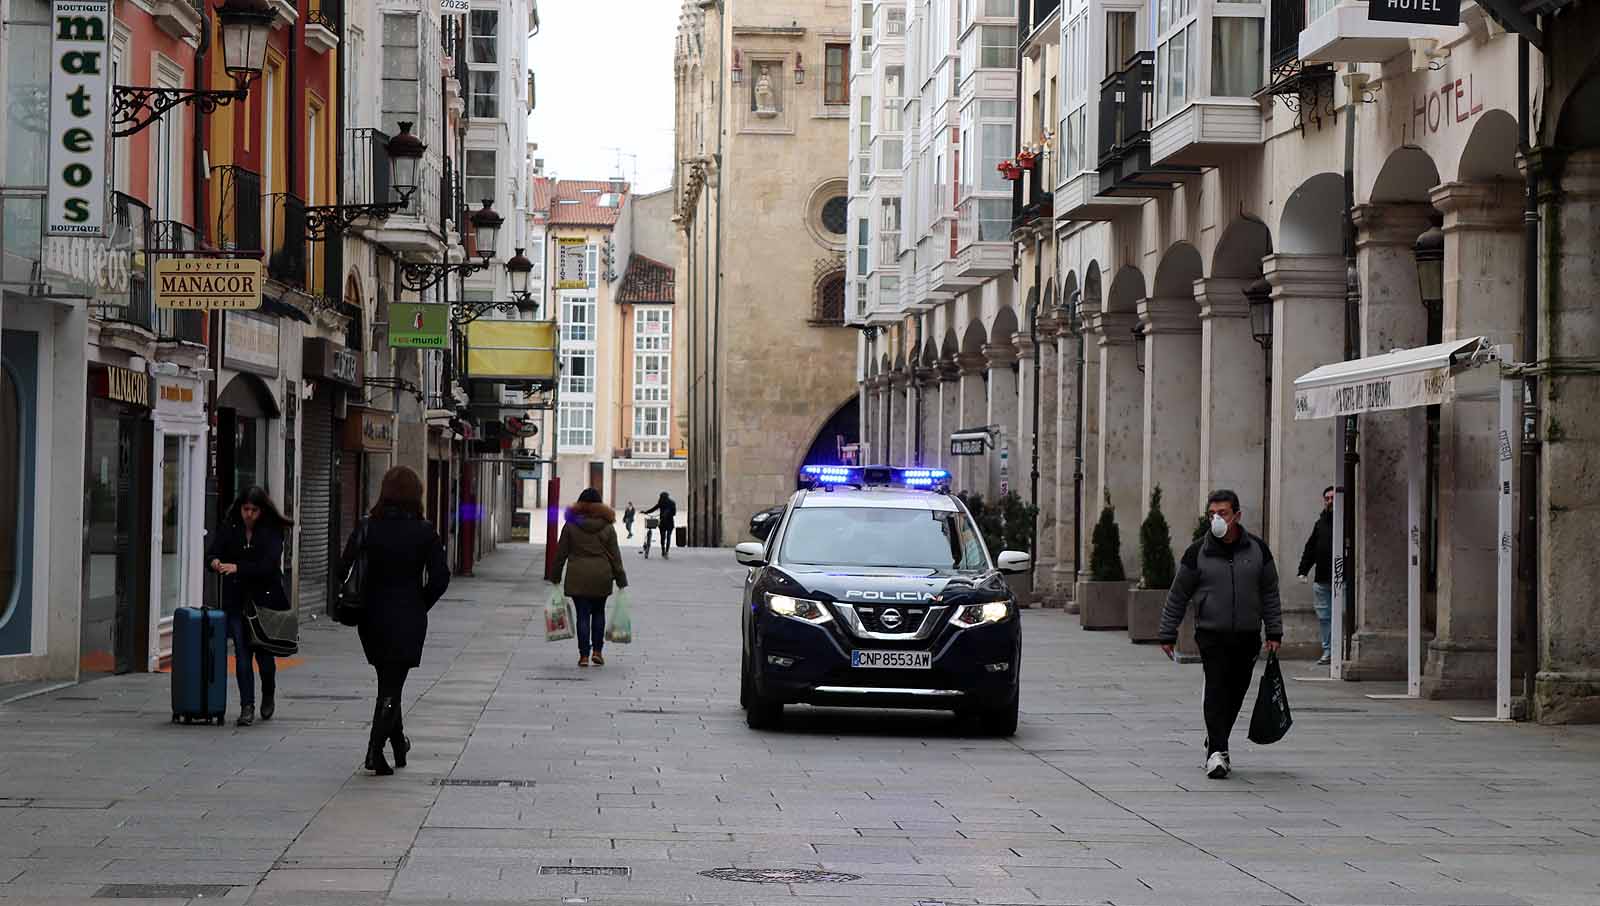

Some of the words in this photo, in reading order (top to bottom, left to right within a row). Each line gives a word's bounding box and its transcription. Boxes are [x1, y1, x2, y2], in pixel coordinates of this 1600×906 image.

[57, 4, 106, 12] BOUTIQUE
[1387, 0, 1441, 11] HOTEL
[1412, 72, 1483, 139] HOTEL
[57, 16, 105, 222] mateos
[51, 224, 101, 233] BOUTIQUE
[160, 276, 255, 293] MANACOR
[107, 365, 149, 407] MANACOR
[846, 590, 934, 601] POLICIA
